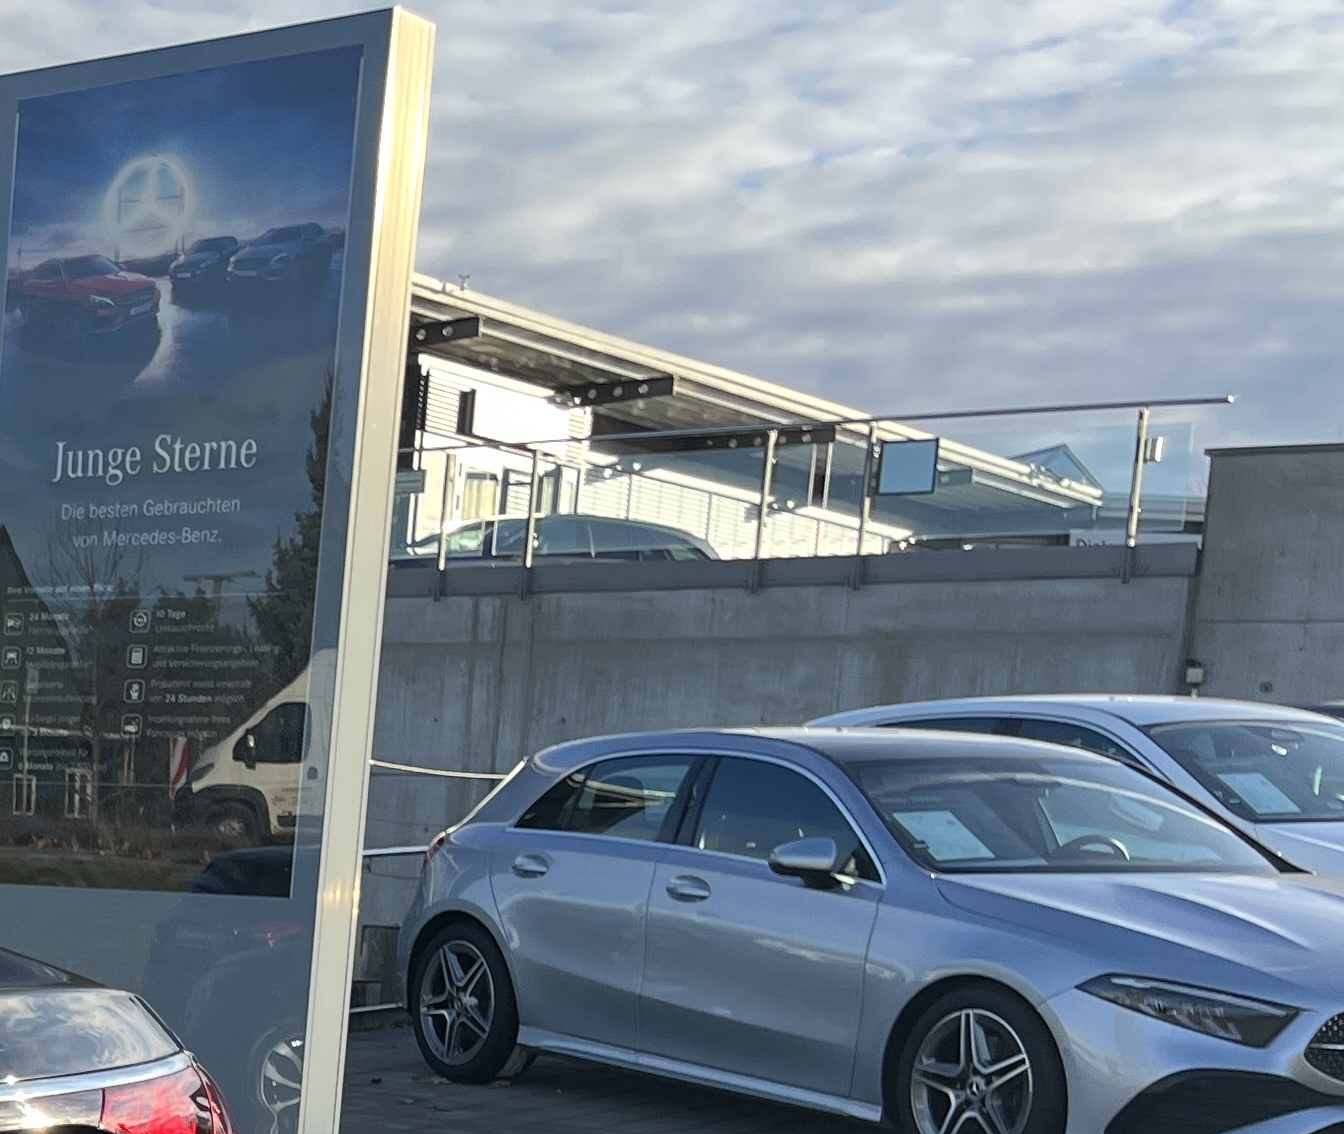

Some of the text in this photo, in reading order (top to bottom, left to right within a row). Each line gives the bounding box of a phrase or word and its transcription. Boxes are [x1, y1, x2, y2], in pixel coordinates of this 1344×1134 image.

[51, 434, 258, 487] Junge Sterne
[61, 497, 241, 521] Die besten Gebrauchten
[72, 526, 223, 549] von Mercedes-Benz.
